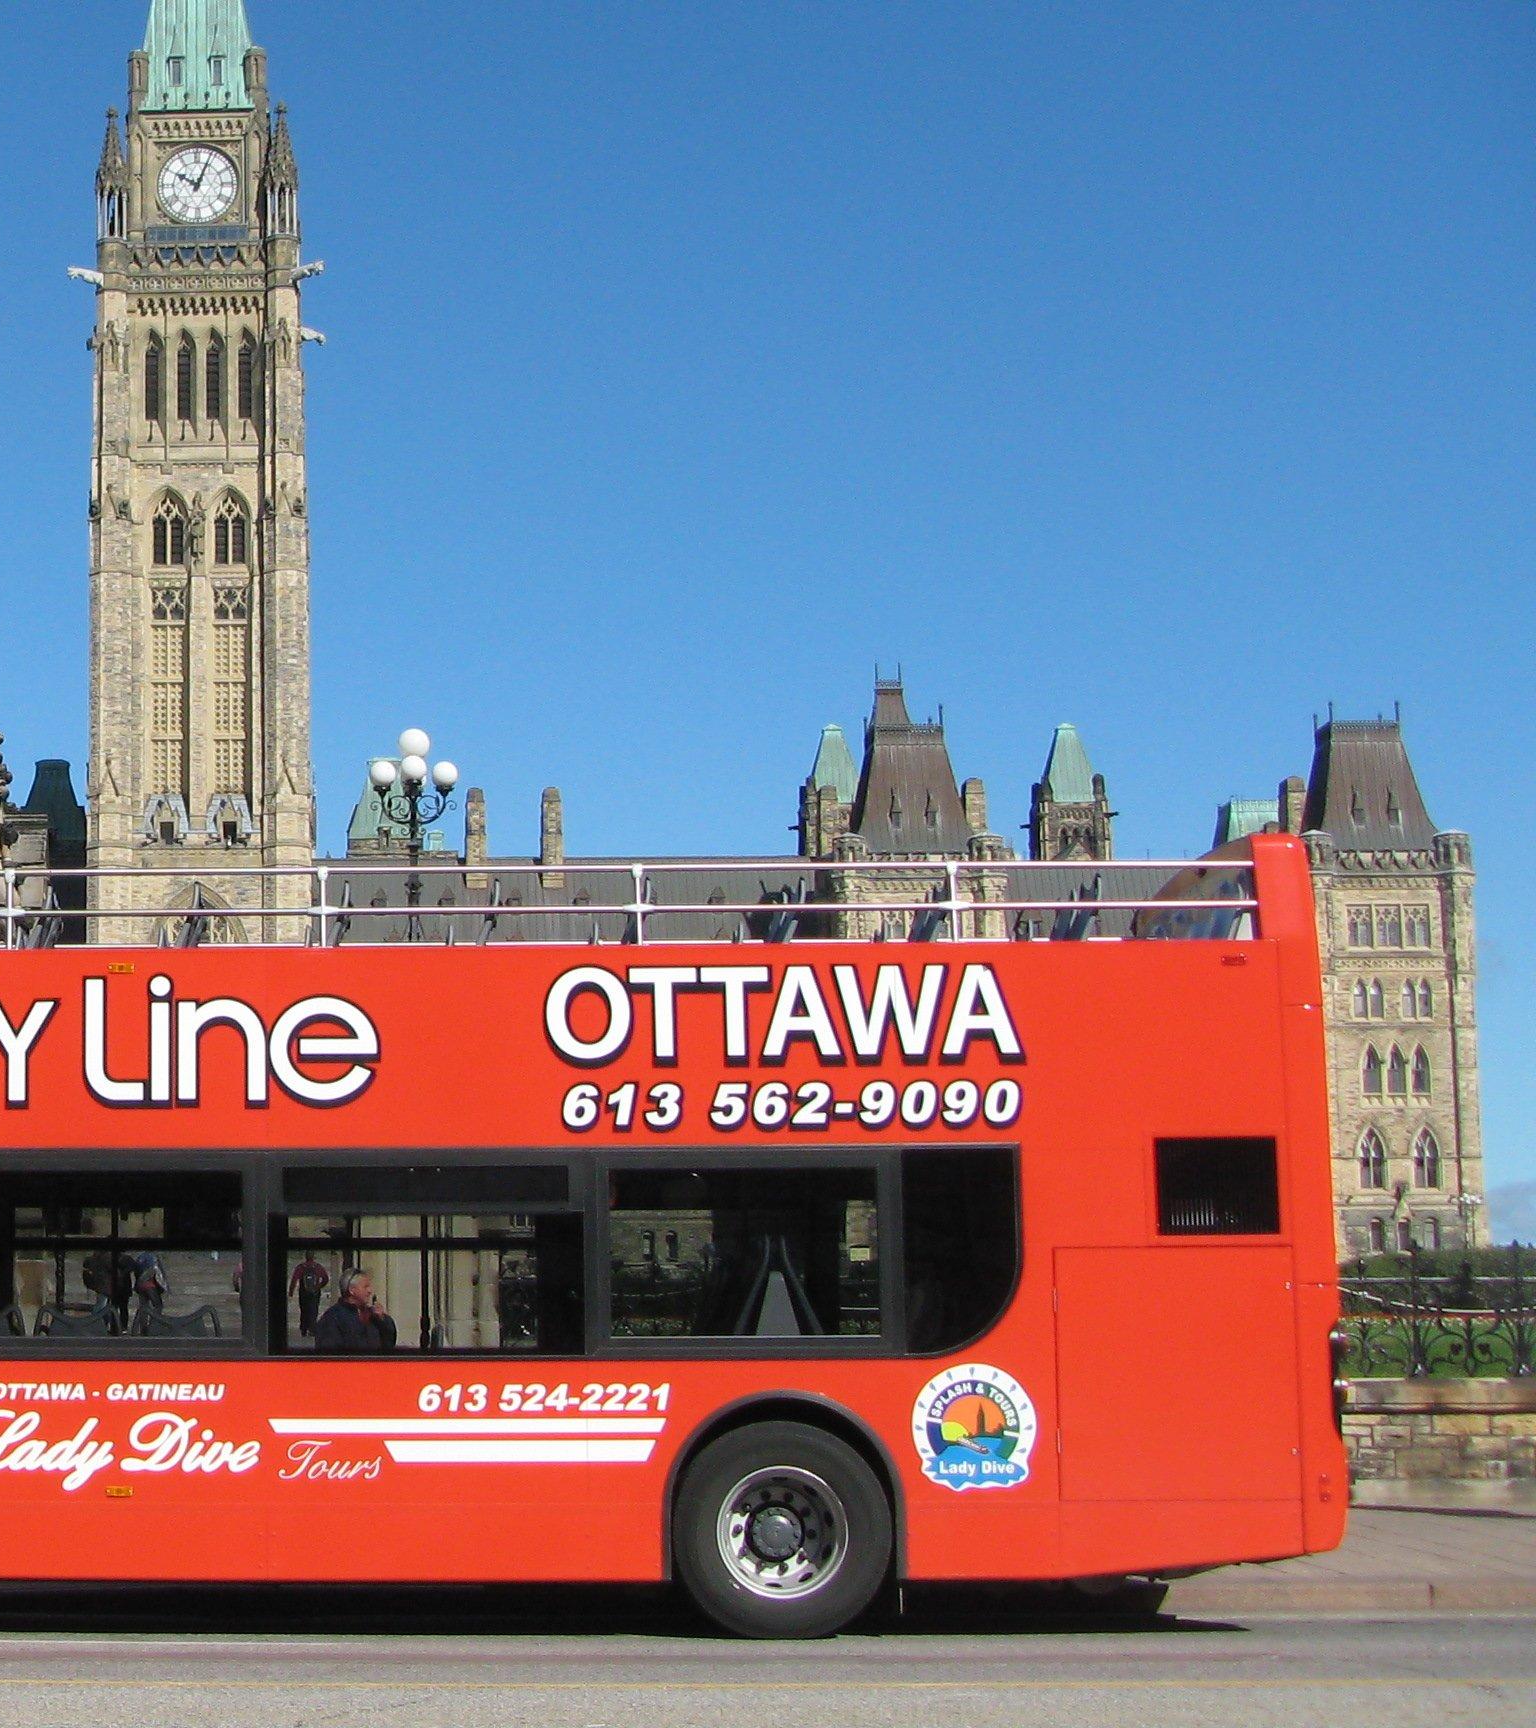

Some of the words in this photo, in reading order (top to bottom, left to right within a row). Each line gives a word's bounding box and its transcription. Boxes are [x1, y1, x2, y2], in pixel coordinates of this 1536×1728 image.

[544, 963, 1026, 1067] OTTAWA
[81, 972, 381, 1108] Line
[562, 1081, 683, 1131] 613
[710, 1079, 1021, 1130] 562-9090
[105, 1383, 225, 1401] GATINEAU
[417, 1383, 489, 1412] 613
[498, 1382, 671, 1412] 524-2221
[931, 1383, 972, 1417] SPLASH
[975, 1383, 985, 1394] &
[988, 1387, 1018, 1427] TOURS
[119, 1411, 261, 1473] Dive
[278, 1440, 383, 1480] Tours
[939, 1460, 976, 1477] Lady
[981, 1460, 1015, 1475] Dive
